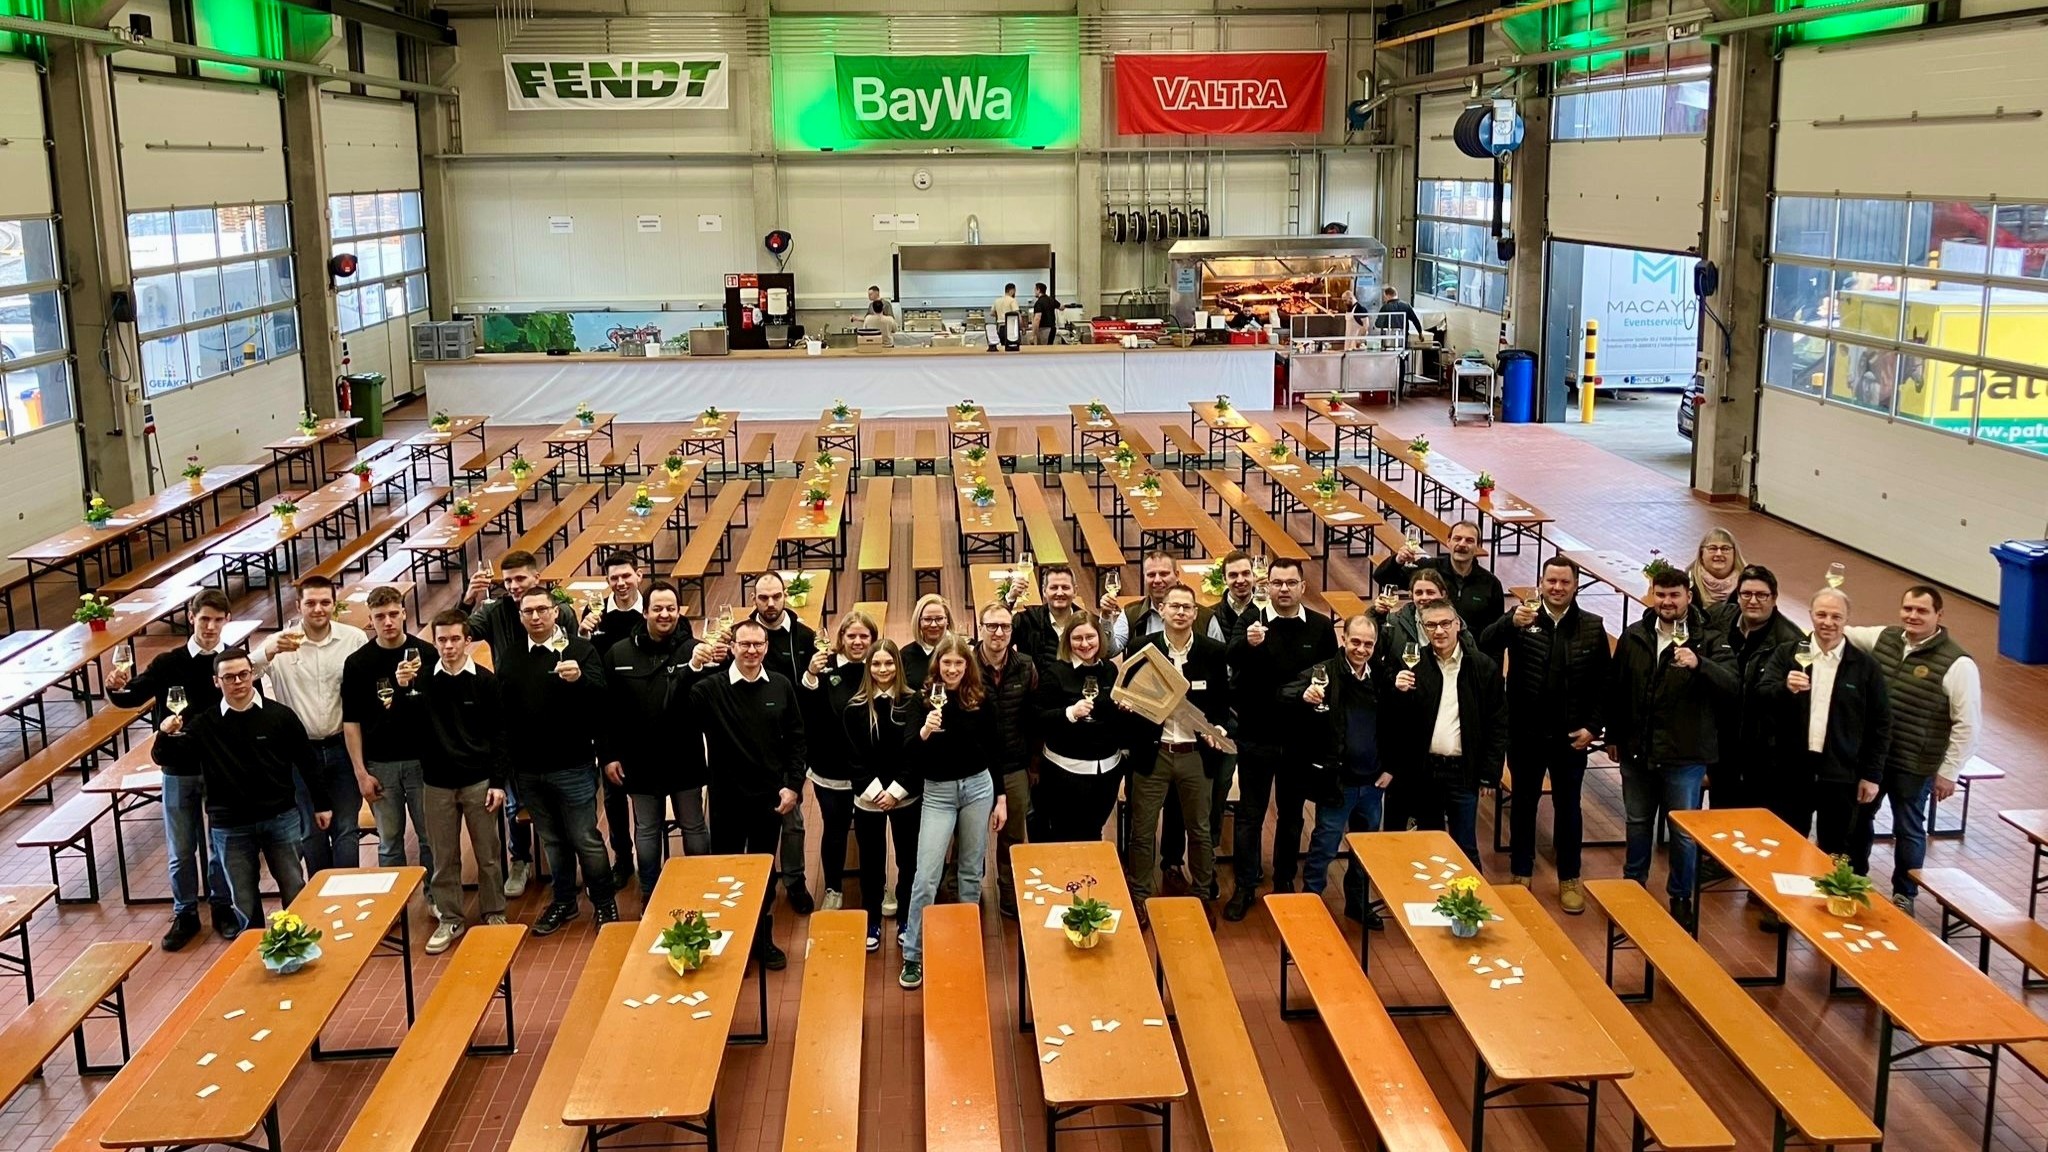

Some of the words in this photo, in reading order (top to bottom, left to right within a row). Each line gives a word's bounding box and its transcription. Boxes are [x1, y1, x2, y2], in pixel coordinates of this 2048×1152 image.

[511, 61, 722, 98] FENDT
[1152, 76, 1288, 110] VALTRA
[852, 76, 1012, 131] BayWa
[1607, 299, 1697, 313] MACAYA
[1624, 318, 1683, 327] Eventservice
